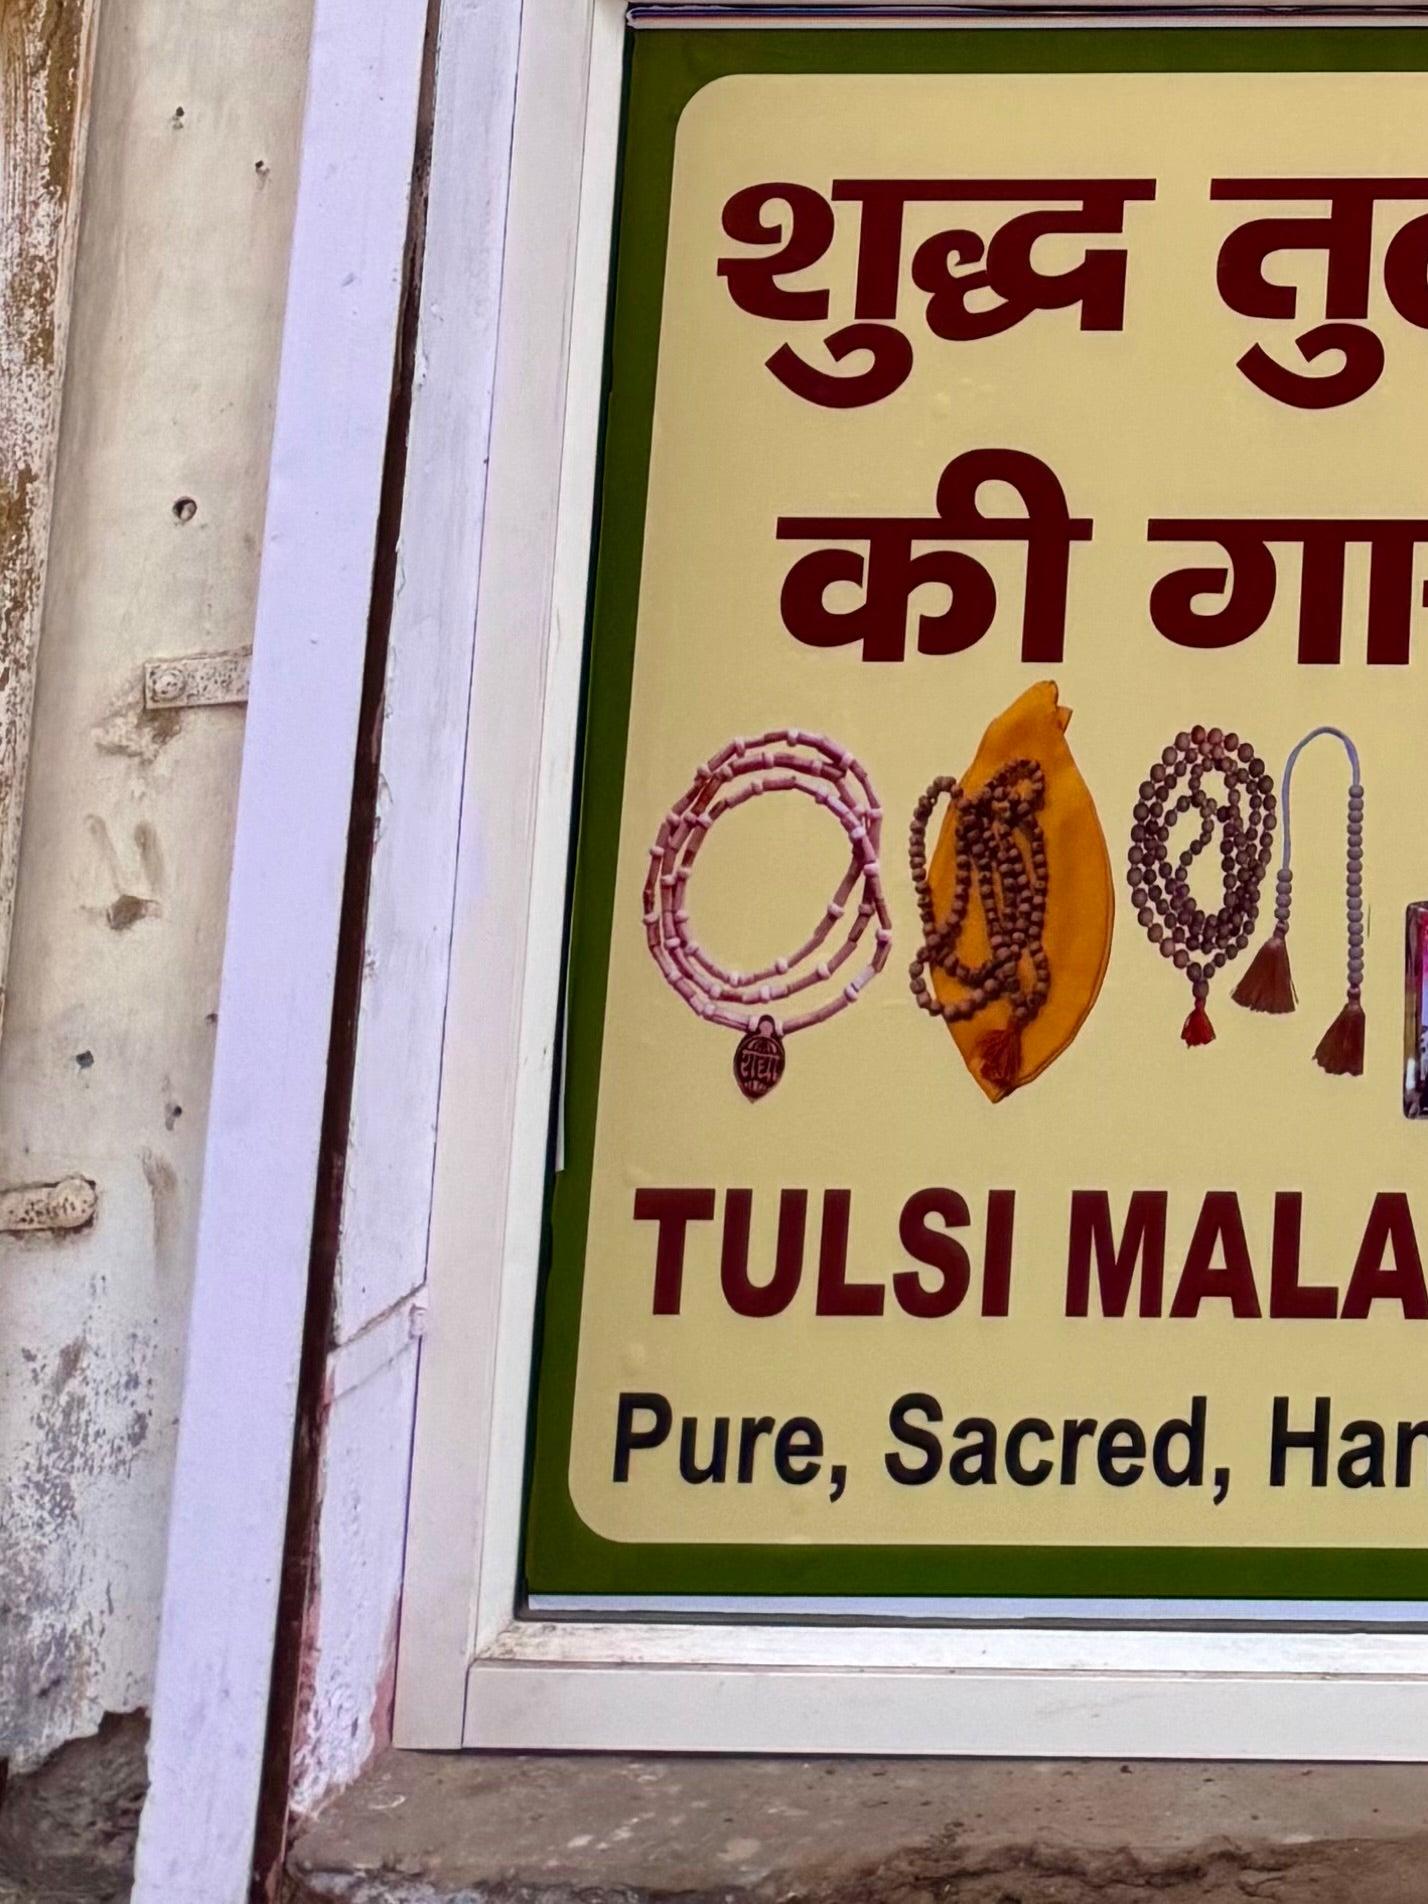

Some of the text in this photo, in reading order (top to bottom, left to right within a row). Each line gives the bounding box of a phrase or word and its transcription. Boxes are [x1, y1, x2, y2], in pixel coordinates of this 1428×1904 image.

[717, 179, 1156, 409] शुद्ध
[776, 449, 1093, 663] की
[634, 1188, 1015, 1318] TULSI
[613, 1393, 846, 1502] Pure,
[885, 1393, 1229, 1505] Sacred,
